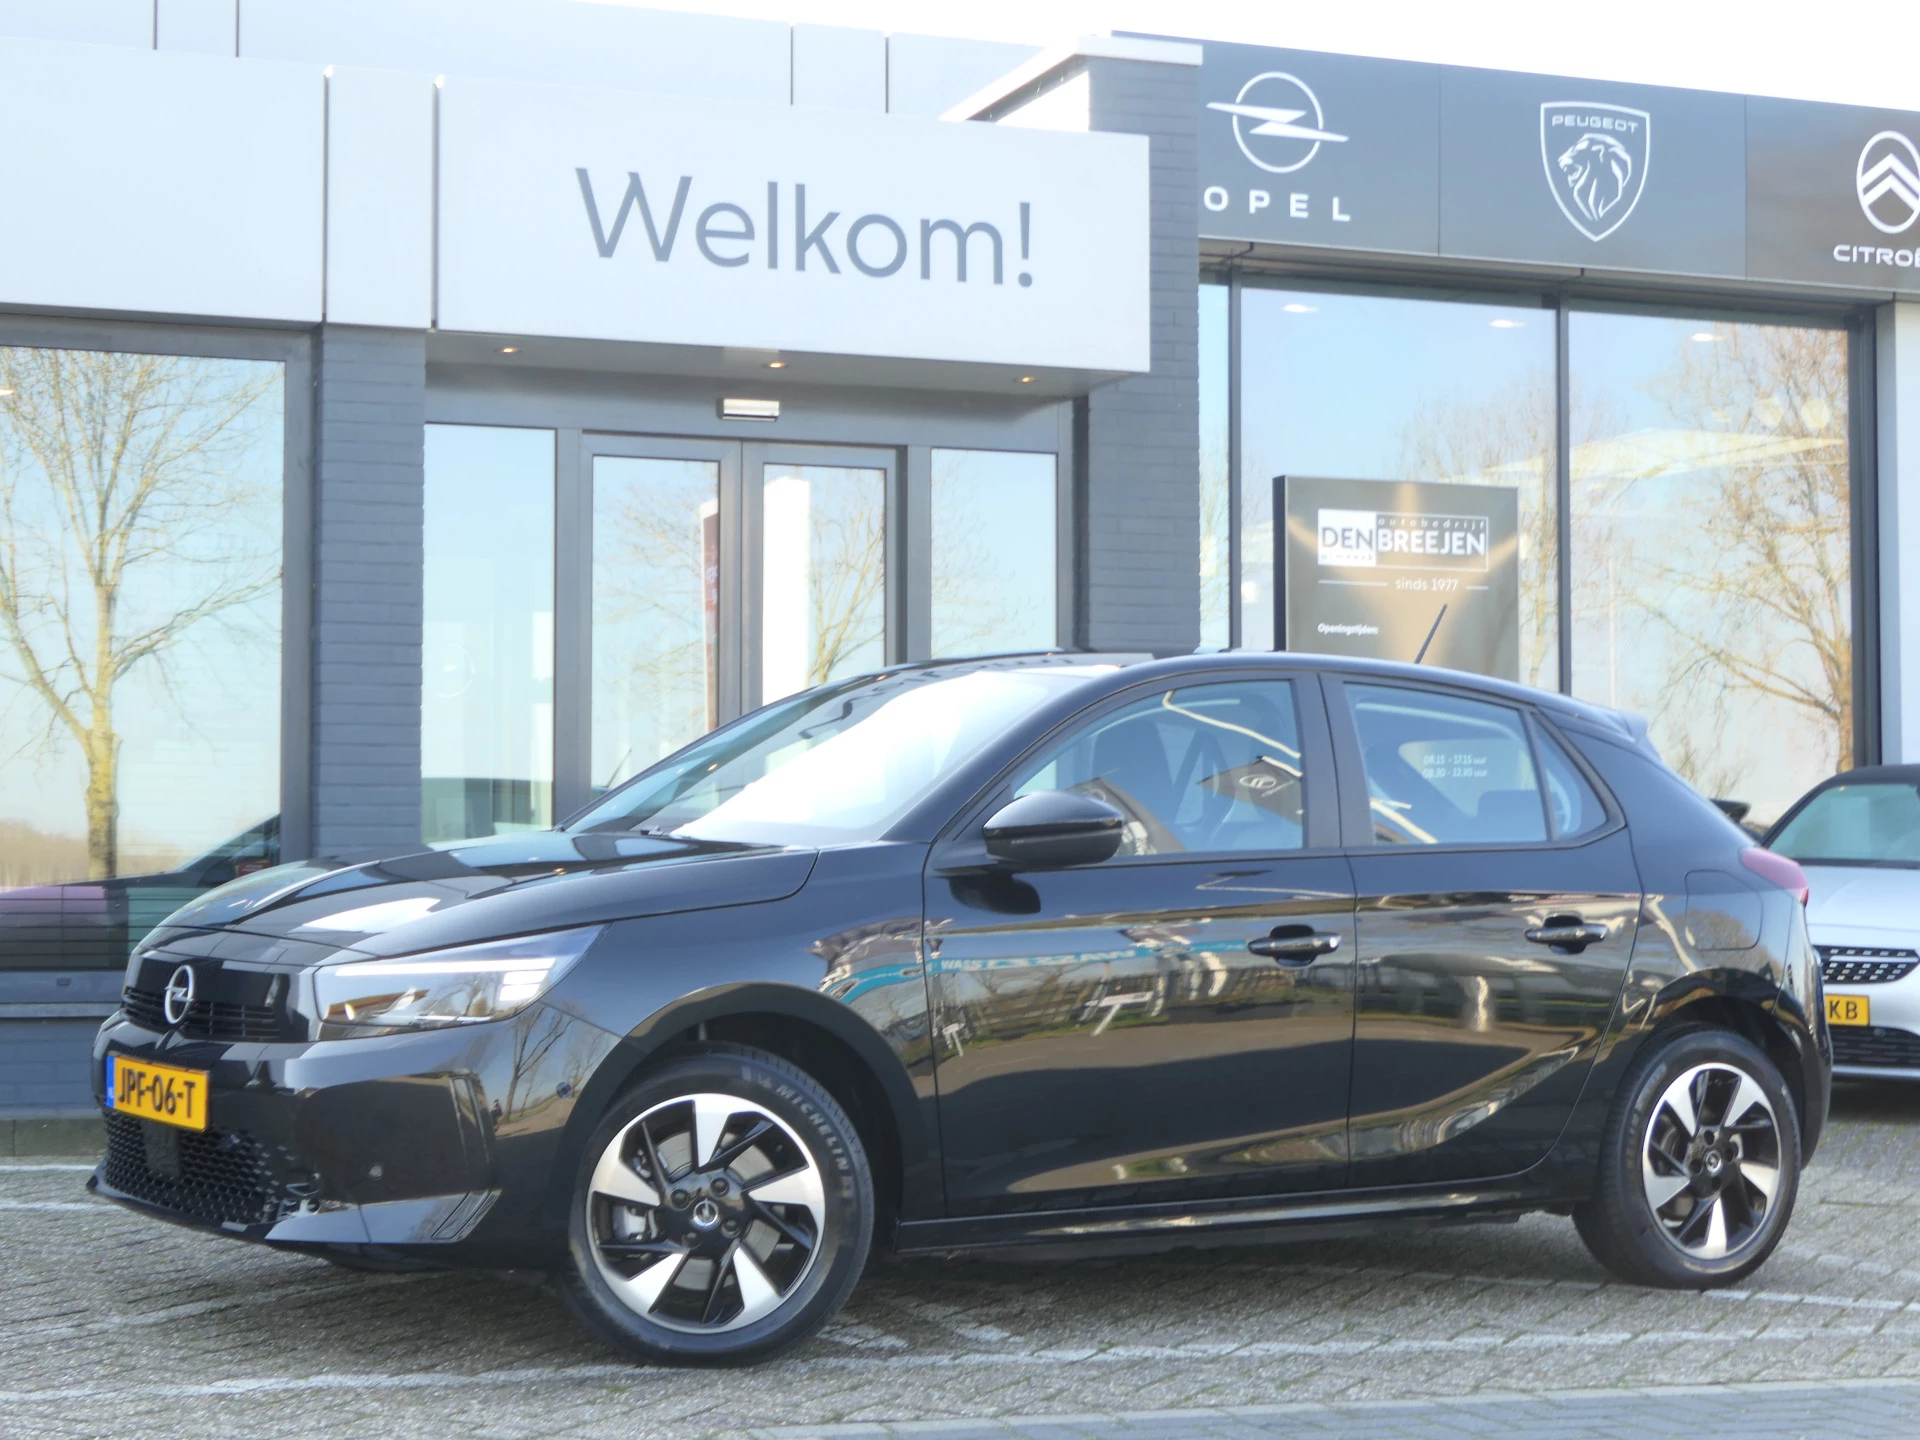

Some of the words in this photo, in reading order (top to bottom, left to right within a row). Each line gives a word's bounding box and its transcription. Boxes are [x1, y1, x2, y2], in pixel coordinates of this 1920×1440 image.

[1551, 113, 1639, 134] PEUGEOT
[1203, 186, 1351, 222] OPEL
[575, 167, 1033, 288] Welkom!
[1321, 526, 1373, 551] DEN
[1377, 528, 1486, 556] BREEJEN
[1394, 576, 1428, 591] sinds
[1430, 577, 1459, 592] 1977
[1829, 1000, 1859, 1020] KB
[118, 1067, 197, 1119] JPF-06-T
[776, 1083, 850, 1171] MICHELIN
